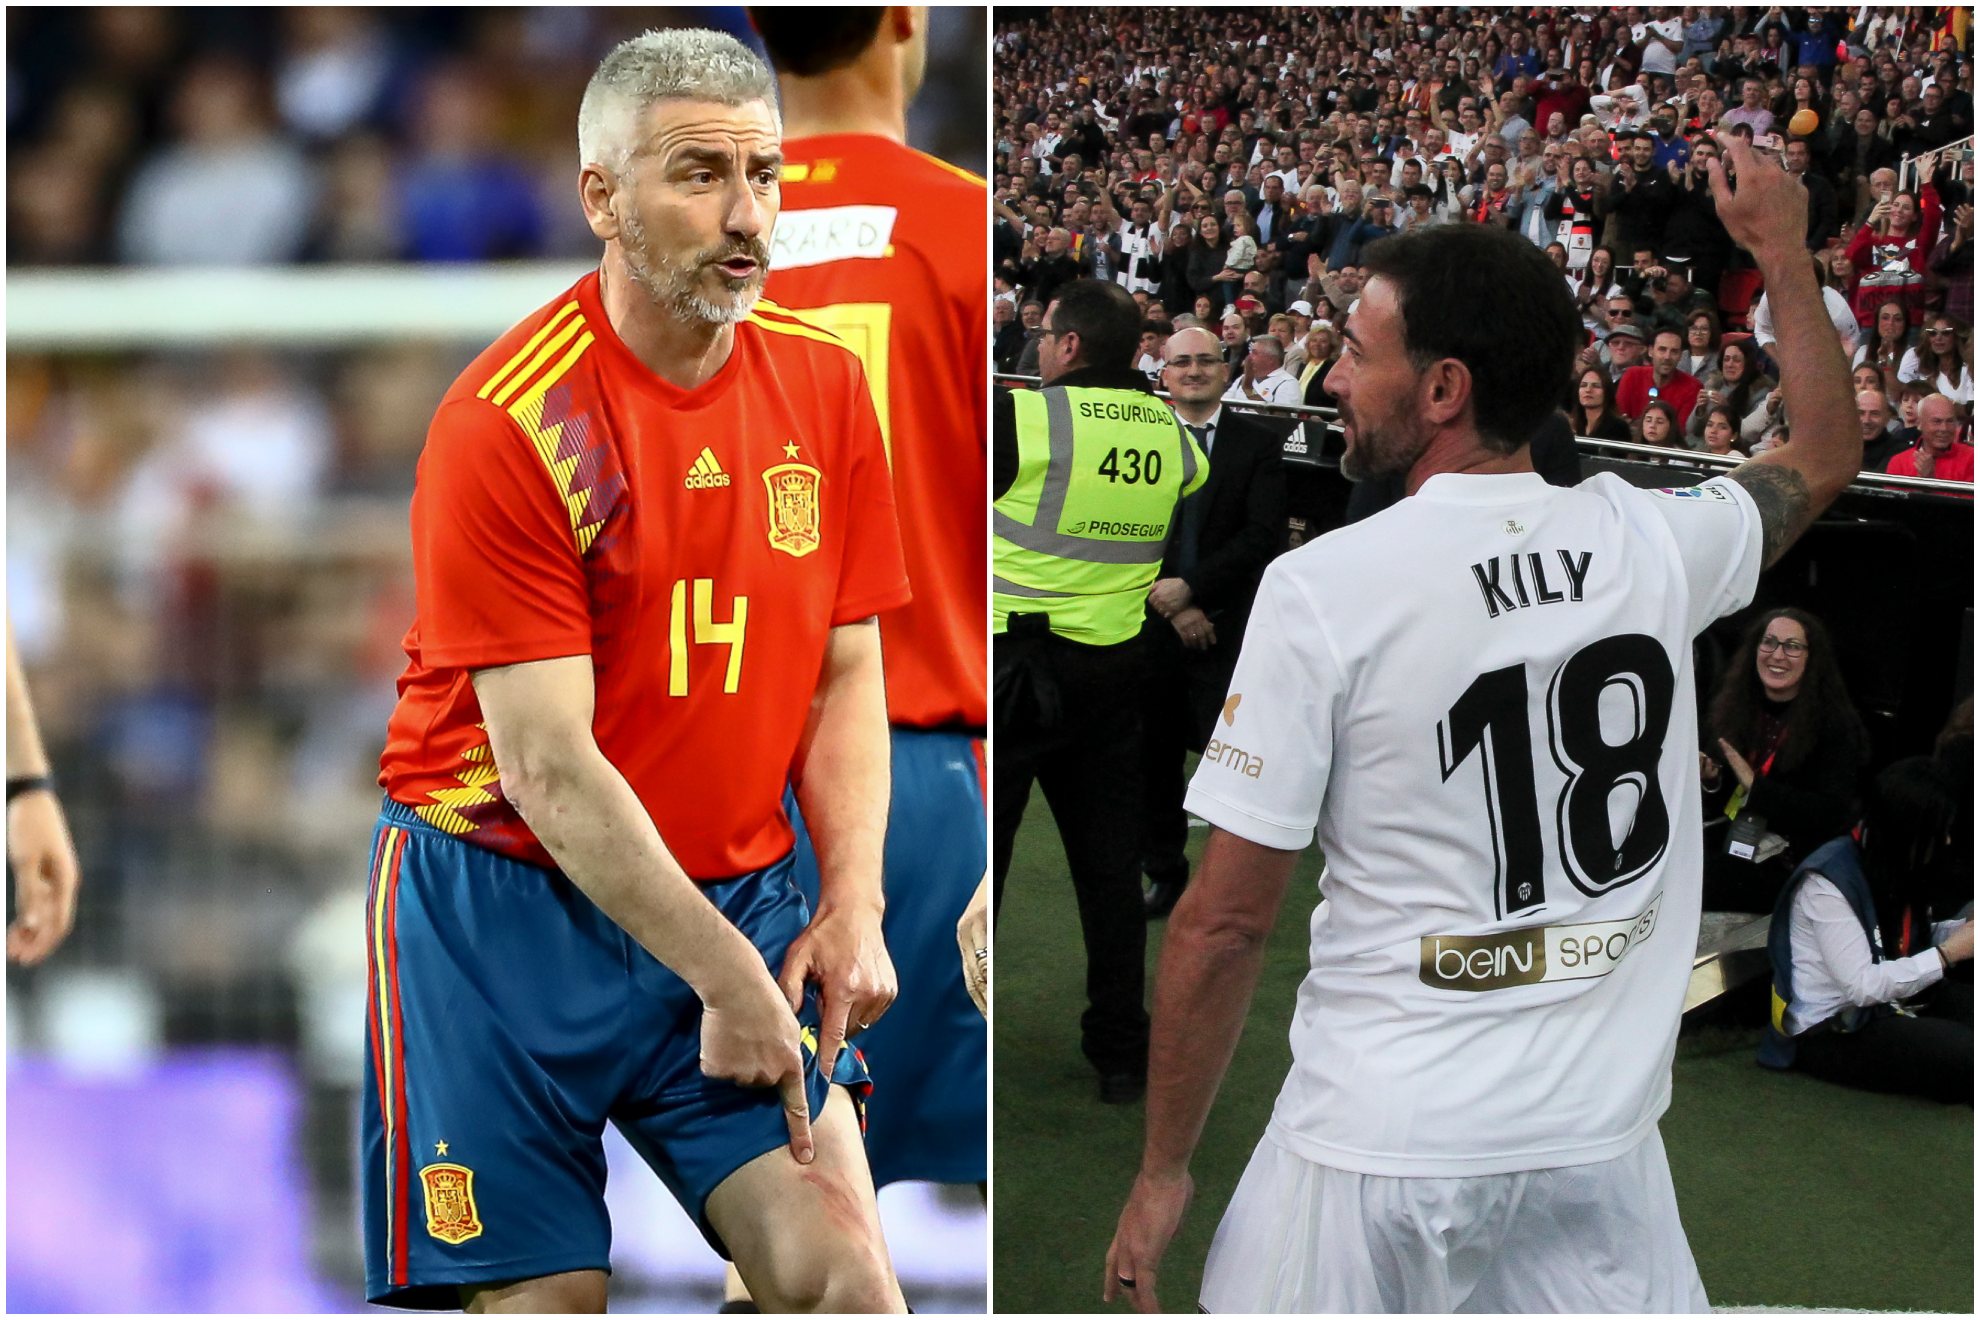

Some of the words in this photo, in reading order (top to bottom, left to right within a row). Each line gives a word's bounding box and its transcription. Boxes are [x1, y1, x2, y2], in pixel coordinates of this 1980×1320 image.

[1080, 402, 1172, 426] SEGURIDAD
[685, 472, 731, 489] adidas
[1098, 447, 1161, 485] 430
[1088, 521, 1164, 537] PROSEGUR
[1471, 549, 1593, 618] KILY
[669, 578, 748, 696] 14
[1436, 634, 1676, 921] 18
